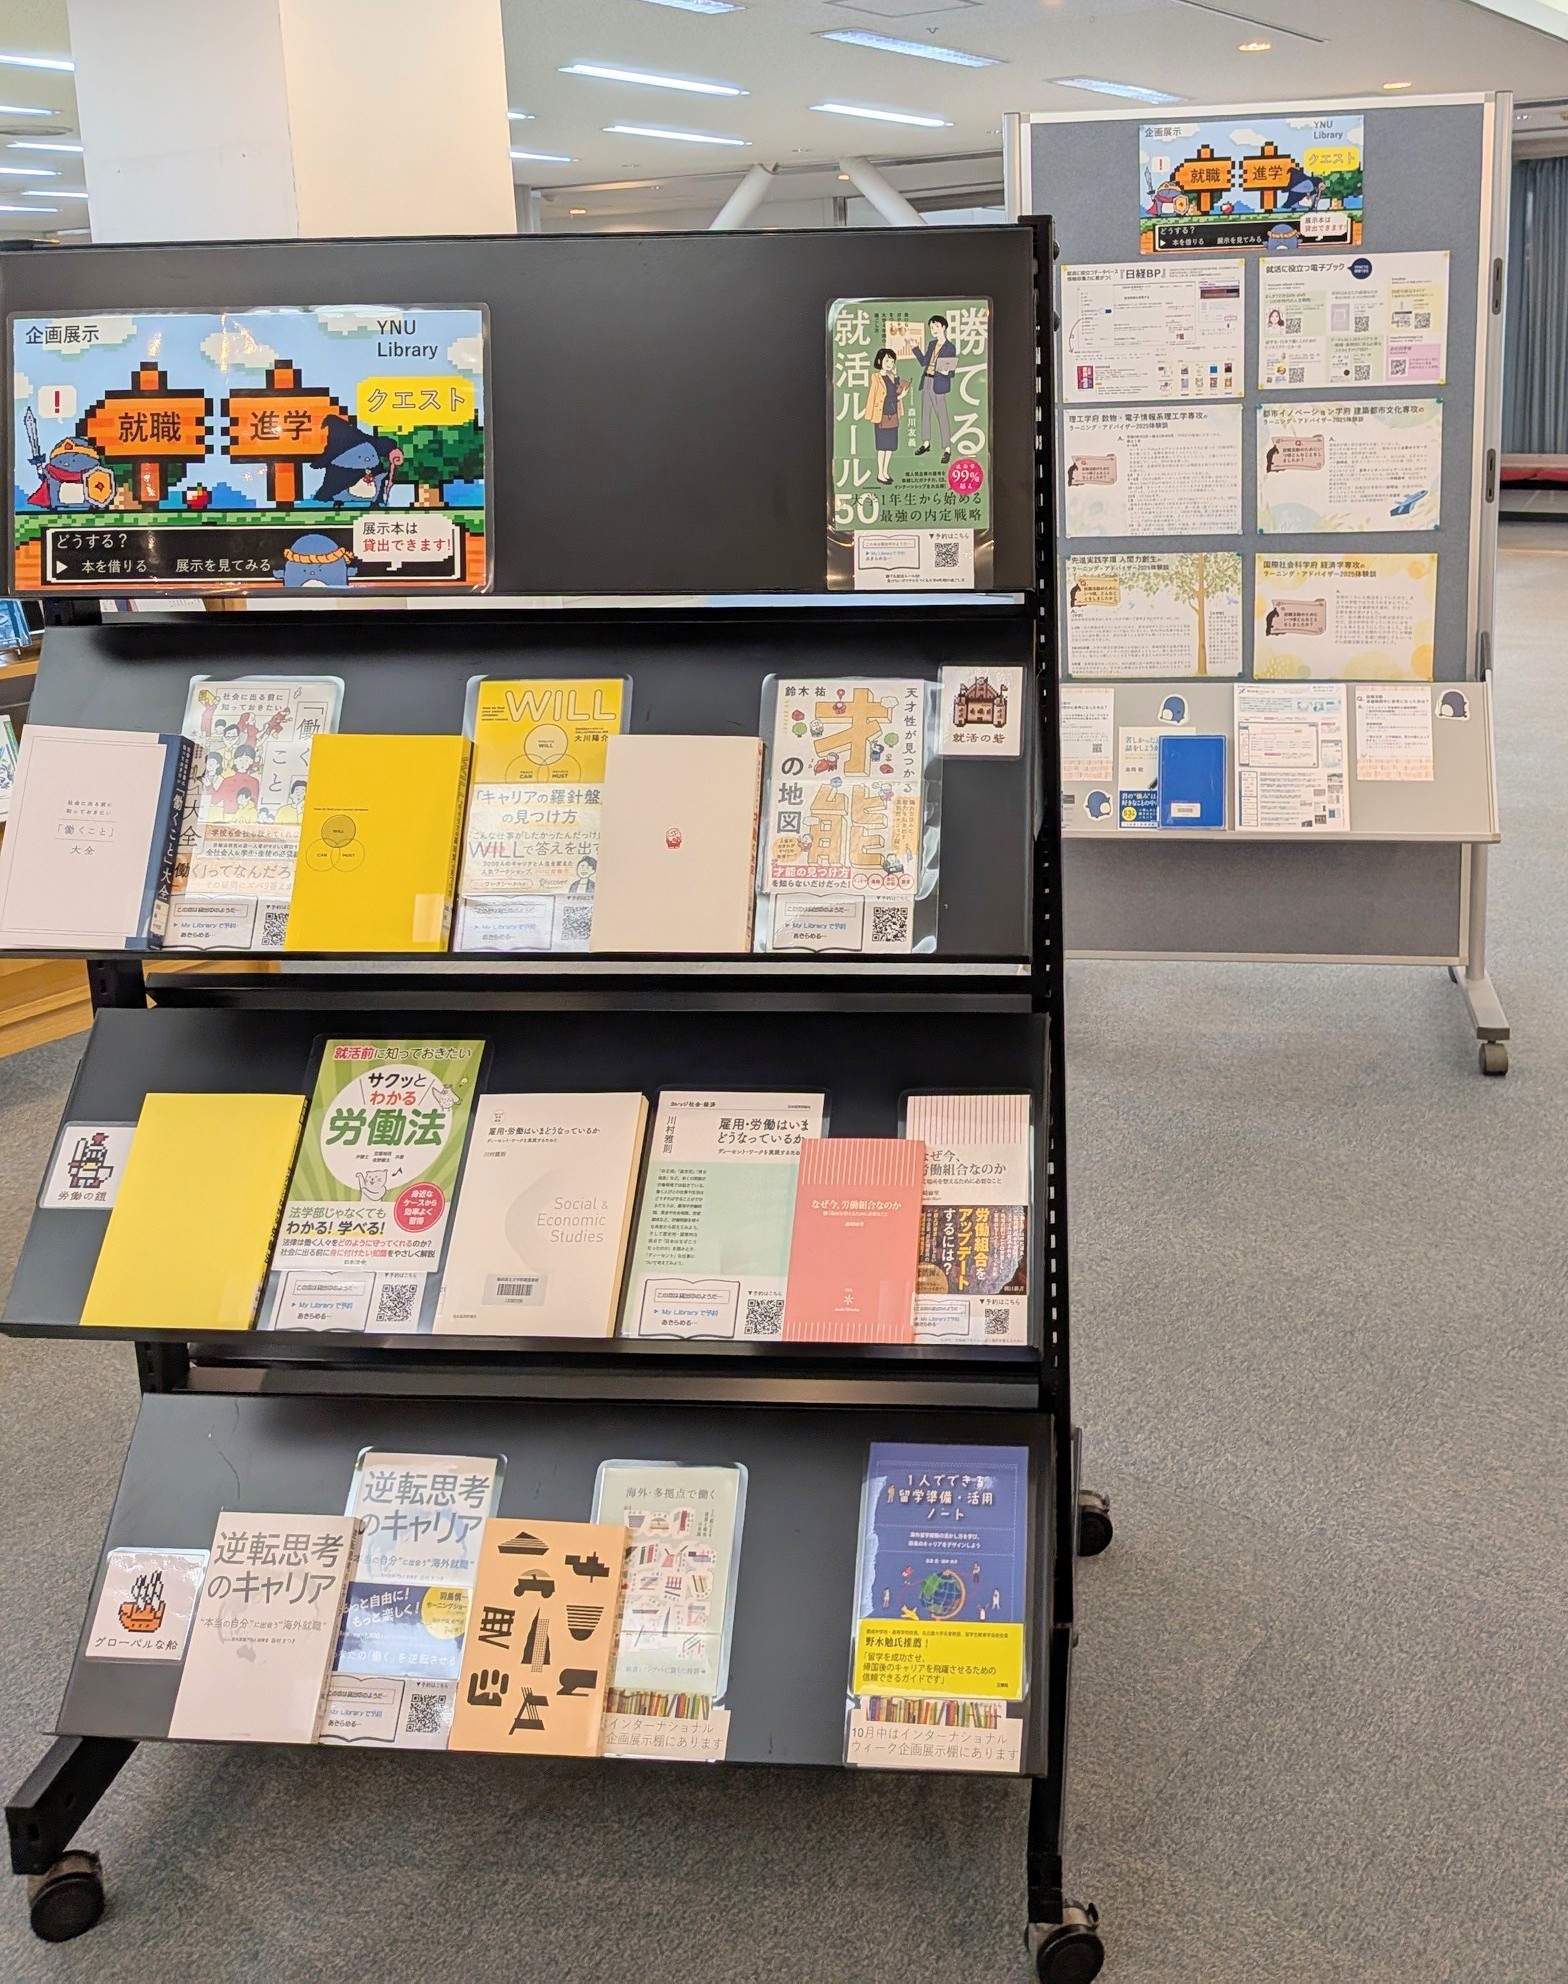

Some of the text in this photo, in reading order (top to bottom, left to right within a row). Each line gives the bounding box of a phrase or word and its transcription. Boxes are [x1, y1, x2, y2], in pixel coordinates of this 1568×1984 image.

[1144, 127, 1182, 137] 企画展示
[1313, 121, 1333, 129] YNU
[1313, 130, 1343, 140] Library
[1308, 152, 1356, 165] クエスト
[1190, 168, 1221, 183] 就職
[1252, 166, 1283, 181] 進学
[1304, 216, 1331, 225] 展示本は
[1160, 226, 1196, 236] どうする？
[1172, 236, 1263, 246] 本を借りる 展示を見てみる
[1265, 263, 1345, 273] 就活に役立つ電子ブック
[377, 320, 416, 335] YNU
[25, 325, 100, 345] 企画展示
[377, 341, 438, 360] Library
[946, 308, 988, 457] 勝てる
[368, 388, 466, 411] クエスト
[1263, 405, 1424, 417] 都市イノベーション学府 建築都市文化専攻の
[1069, 414, 1099, 423] 理工学府
[118, 412, 181, 443] 就職
[250, 411, 313, 441] 進学
[907, 408, 916, 447] 森川友義
[952, 469, 980, 483] 99%
[851, 492, 982, 507] 大学1年生から始める
[881, 509, 981, 523] 最強の内定戦略
[362, 522, 418, 536] 展示本は
[57, 533, 128, 549] どうする？
[362, 537, 452, 553] 貸出できます!
[81, 557, 271, 573] 本を借りる 展示を見てみる
[1263, 561, 1318, 569] 国際社会科学府
[1264, 570, 1377, 578] ラーニング・アドバイザー2025体験談
[223, 692, 284, 701] 社会に出る前に
[785, 686, 826, 697] 鈴木 祐
[505, 689, 616, 722] WILL
[902, 687, 918, 793] 天才性が見つかる
[777, 757, 804, 834] の地図
[502, 809, 578, 824] の見つけ方
[57, 824, 114, 837] 「働くこと」
[70, 845, 95, 855] 大全
[772, 867, 851, 878] 才能の見つけ方
[334, 1045, 471, 1060] 就活前に知っておきたい
[368, 1073, 428, 1088] サクッと
[369, 1091, 417, 1106] わかる
[326, 1108, 446, 1147] 労働法
[488, 1126, 600, 1136] 雇用・労働はいまどうなっているか
[719, 1117, 809, 1131] 雇用・労働はいま
[662, 1115, 677, 1154] 川村雅則
[717, 1131, 805, 1144] どうなっているか
[403, 1199, 437, 1207] ケースから
[554, 1197, 608, 1210] Social &
[811, 1200, 901, 1210] なぜ今、労働組合なのか
[289, 1206, 386, 1219] 法学部じゃなくても
[404, 1208, 432, 1216] 効率よく
[537, 1213, 606, 1226] Economic
[286, 1221, 385, 1235] わかる！ 学べる！
[281, 1238, 432, 1247] 法律は働く人々をどのように守ってくれるのか？
[550, 1229, 604, 1243] Studies
[942, 1208, 956, 1275] するには？
[957, 1208, 973, 1291] アップデート
[974, 1207, 990, 1280] 労働組合を
[280, 1249, 435, 1258] 社会に出る前に身に付けたい知識をやさしく解説
[908, 1474, 984, 1488] 1人でできる
[363, 1470, 490, 1509] 逆転思考
[625, 1486, 716, 1500] 海外・多拠点で働く
[899, 1489, 993, 1505] 留学準備・活用
[927, 1508, 964, 1520] ノート
[360, 1509, 483, 1543] のキャリア
[214, 1532, 344, 1568] 逆転思考
[207, 1570, 337, 1605] のキャリア
[352, 1601, 420, 1628] もっと楽しく！
[95, 1637, 178, 1651] グローバルな船
[338, 1650, 456, 1665] なたの「働く」を逆転させる
[863, 1652, 926, 1663] 「留学を成功させ、
[863, 1663, 997, 1675] 帰国後のキャリアを飛躍させるための
[862, 1673, 945, 1684] 信頼できるガイドです」
[606, 1731, 724, 1750] 企画展示棚にあります
[852, 1726, 1008, 1744] 10月中はインターナショナル
[851, 1740, 1019, 1761] ウィーク企画展示棚にあります
